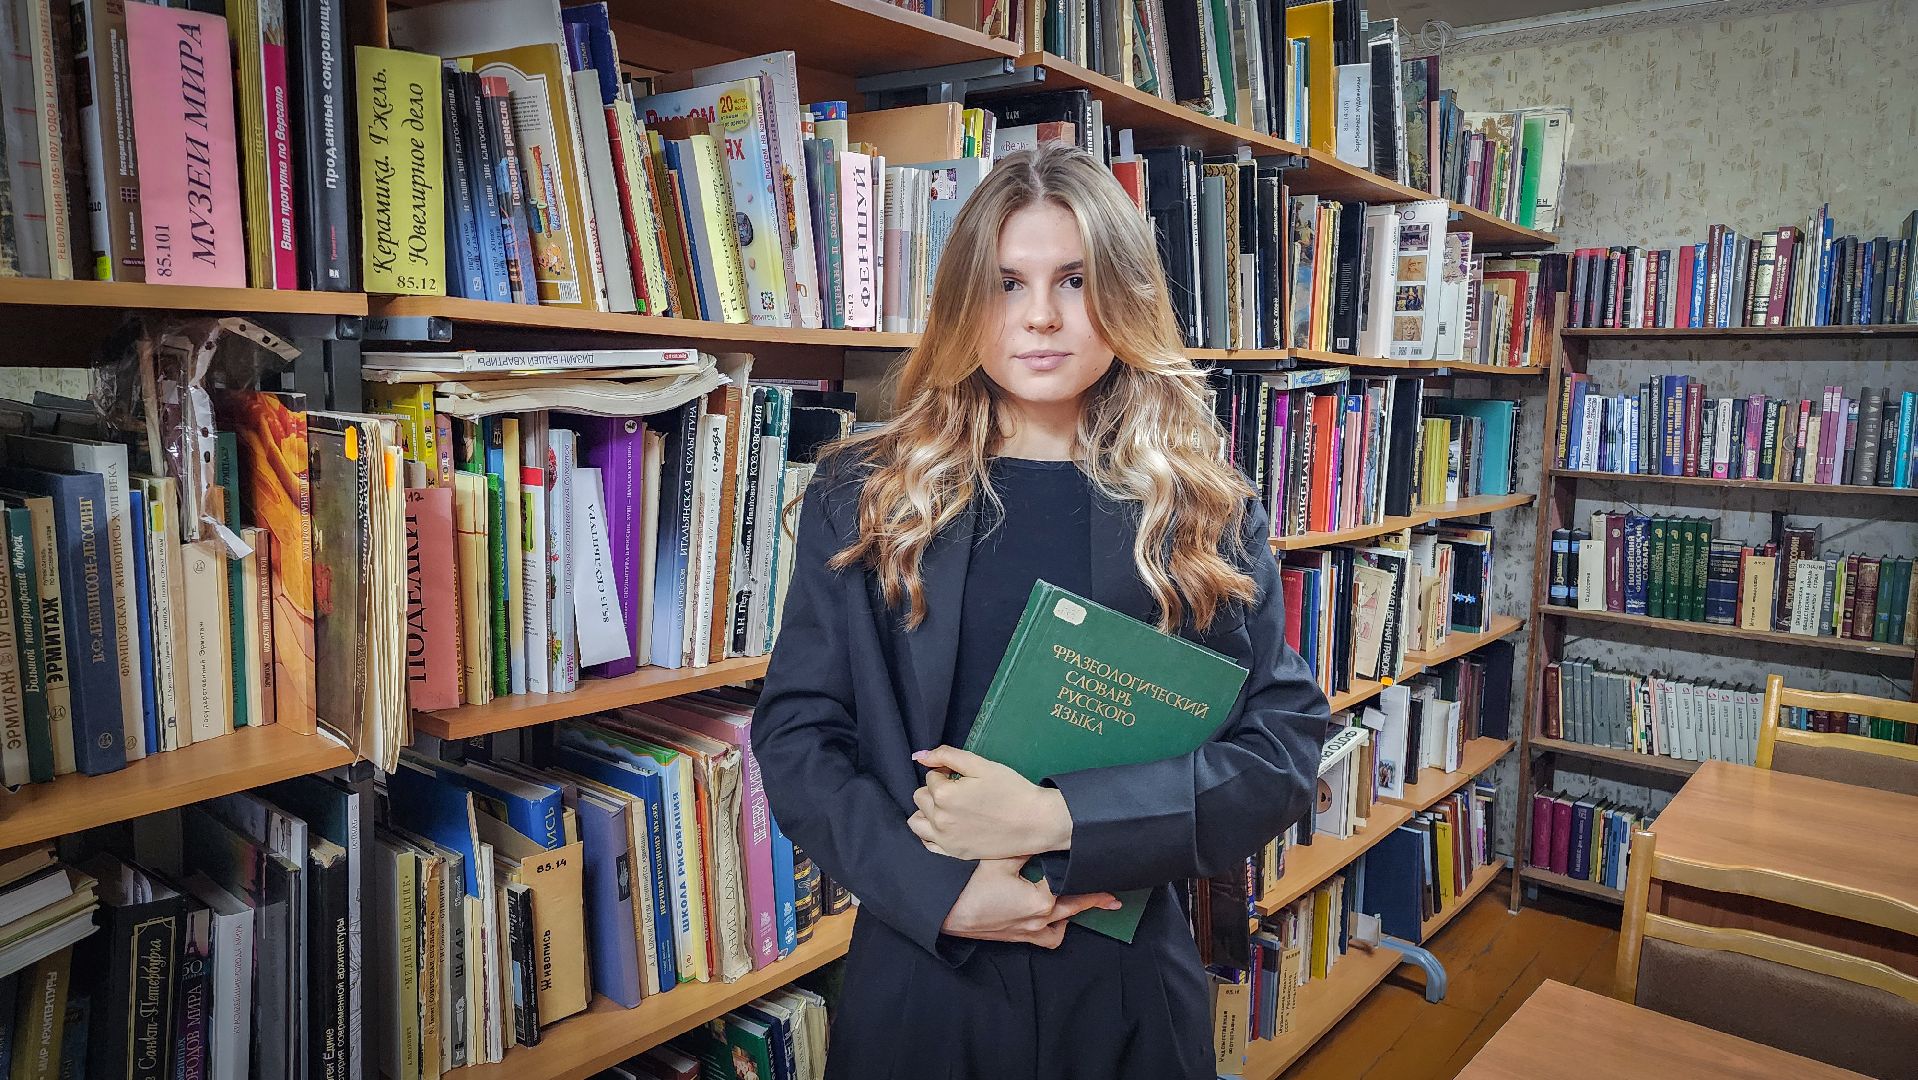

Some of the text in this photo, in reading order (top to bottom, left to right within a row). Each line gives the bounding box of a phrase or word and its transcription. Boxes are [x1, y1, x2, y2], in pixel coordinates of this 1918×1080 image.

[46, 102, 57, 138] ГОДОВ
[719, 97, 734, 113] 20
[1354, 75, 1363, 153] Зарубежные художники
[49, 142, 61, 188] 1905-1907
[118, 140, 128, 176] История
[176, 22, 217, 268] МУЗЕИ МИРА
[273, 86, 293, 251] Ваша прогулка по Версалю
[322, 94, 340, 189] Проданные
[367, 67, 400, 272] Керамика. Гжель.
[401, 81, 432, 266] Ювелирное дело
[498, 99, 520, 206] Гончарное ремесло
[52, 192, 67, 260] РЕВОЛЮЦИЯ
[154, 223, 173, 277] 85.101
[852, 166, 872, 307] ФЕНШУЙ
[396, 275, 437, 291] 85.12
[560, 354, 594, 364] ДИЗАЙН
[685, 404, 698, 474] СКУЛЬПТУРА
[750, 404, 763, 476] КОЗЛОВСКИЙ
[1298, 392, 1314, 530] МИКЕЛАНДЖЕЛО
[1764, 418, 1776, 449] ТРАКТАТ
[11, 534, 26, 569] дворец
[299, 472, 311, 562] ЯНТАРНАЯ КОМНАТА
[588, 503, 606, 593] СКУЛЬПТУРА
[679, 480, 693, 557] ИТАЛЬЯНСКАЯ
[78, 496, 103, 637] ЛЕВИНСОН-ЛЕССИНГ
[108, 461, 131, 677] ФРАНЦУЗСКАЯ ЖИВОПИСЬ XVIII ВЕКА
[1626, 534, 1636, 586] НОВЕЙШИЙ
[1634, 524, 1644, 593] ФИЛОСОФСКИЙ
[1641, 540, 1650, 581] СЛОВАРЬ
[1784, 535, 1801, 610] ИСТОРИЯ ФИЛОСОФИИ
[407, 513, 427, 684] ПОДЕЛКИ
[25, 648, 41, 692] Большой
[41, 596, 64, 684] ЭРМИТАЖ
[196, 620, 210, 728] Государственный Эрмитаж
[1380, 641, 1392, 677] ГРАВЮРА
[0, 670, 22, 750] ЭРМИТАЖ
[1052, 643, 1209, 720] ФРАЗЕОЛОГИЧЕСКИЙ
[1056, 685, 1137, 727] РУССКОГО
[1065, 670, 1133, 707] СЛОВАРЬ
[1050, 703, 1104, 735] ЯЗЫКА
[752, 797, 767, 846] ШЕДЕВРЫ
[536, 857, 568, 874] 85.14
[672, 790, 690, 934] ШКОЛА РИСОВАНИЯ
[336, 917, 346, 980] архитектуры
[454, 927, 465, 978] ШАДР
[540, 928, 553, 992] Живопись
[41, 971, 58, 1040] АРХИТЕКТУРЫ
[138, 937, 164, 1071] Санкт-Петербурга
[336, 980, 346, 1047] современной
